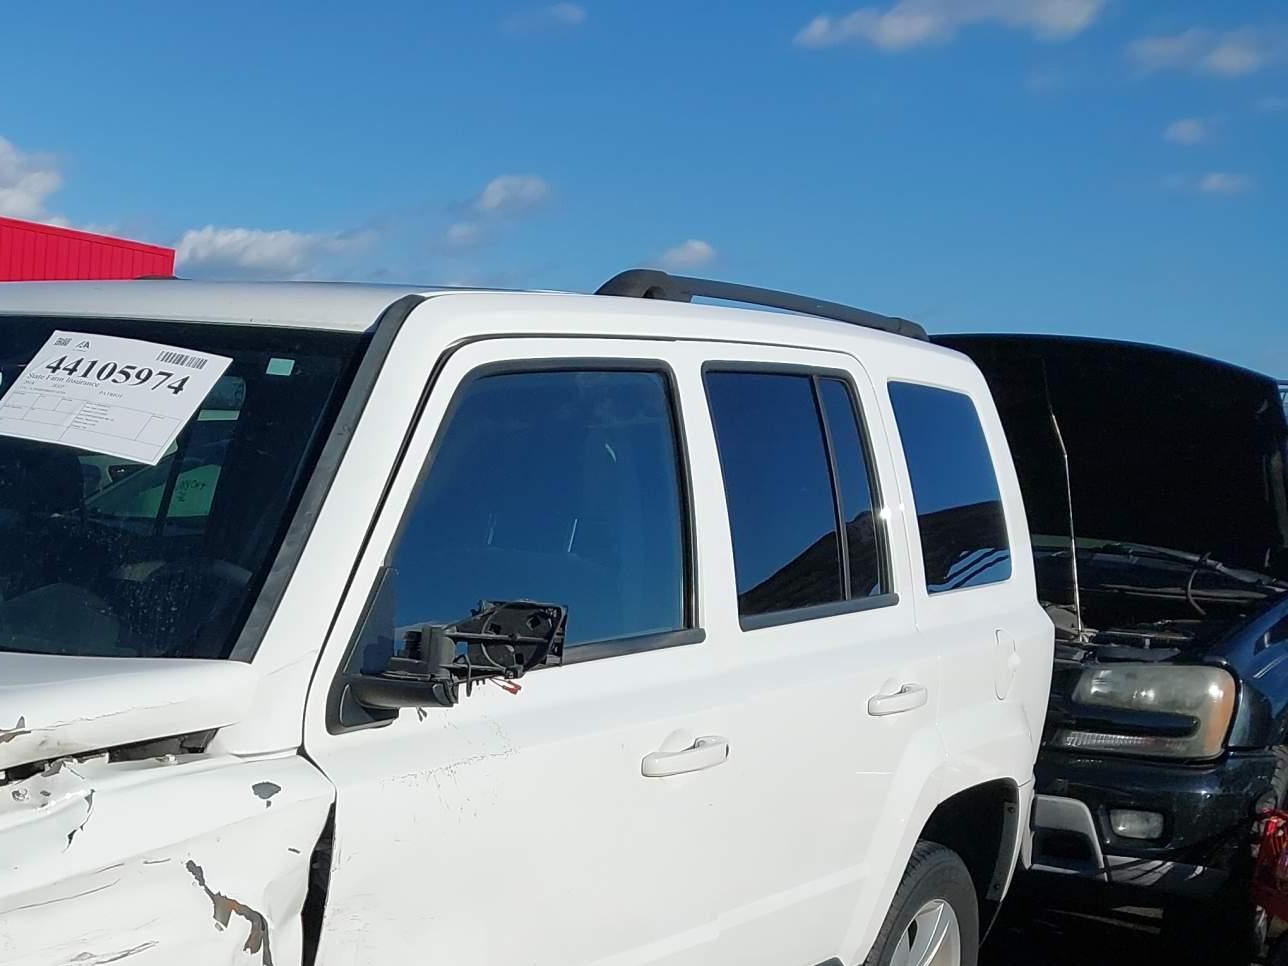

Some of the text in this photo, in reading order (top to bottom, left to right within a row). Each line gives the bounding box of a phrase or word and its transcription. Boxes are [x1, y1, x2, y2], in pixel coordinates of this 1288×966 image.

[27, 372, 45, 381] State
[46, 374, 64, 382] Farm
[65, 375, 100, 388] Insurance
[45, 355, 190, 395] 44105974
